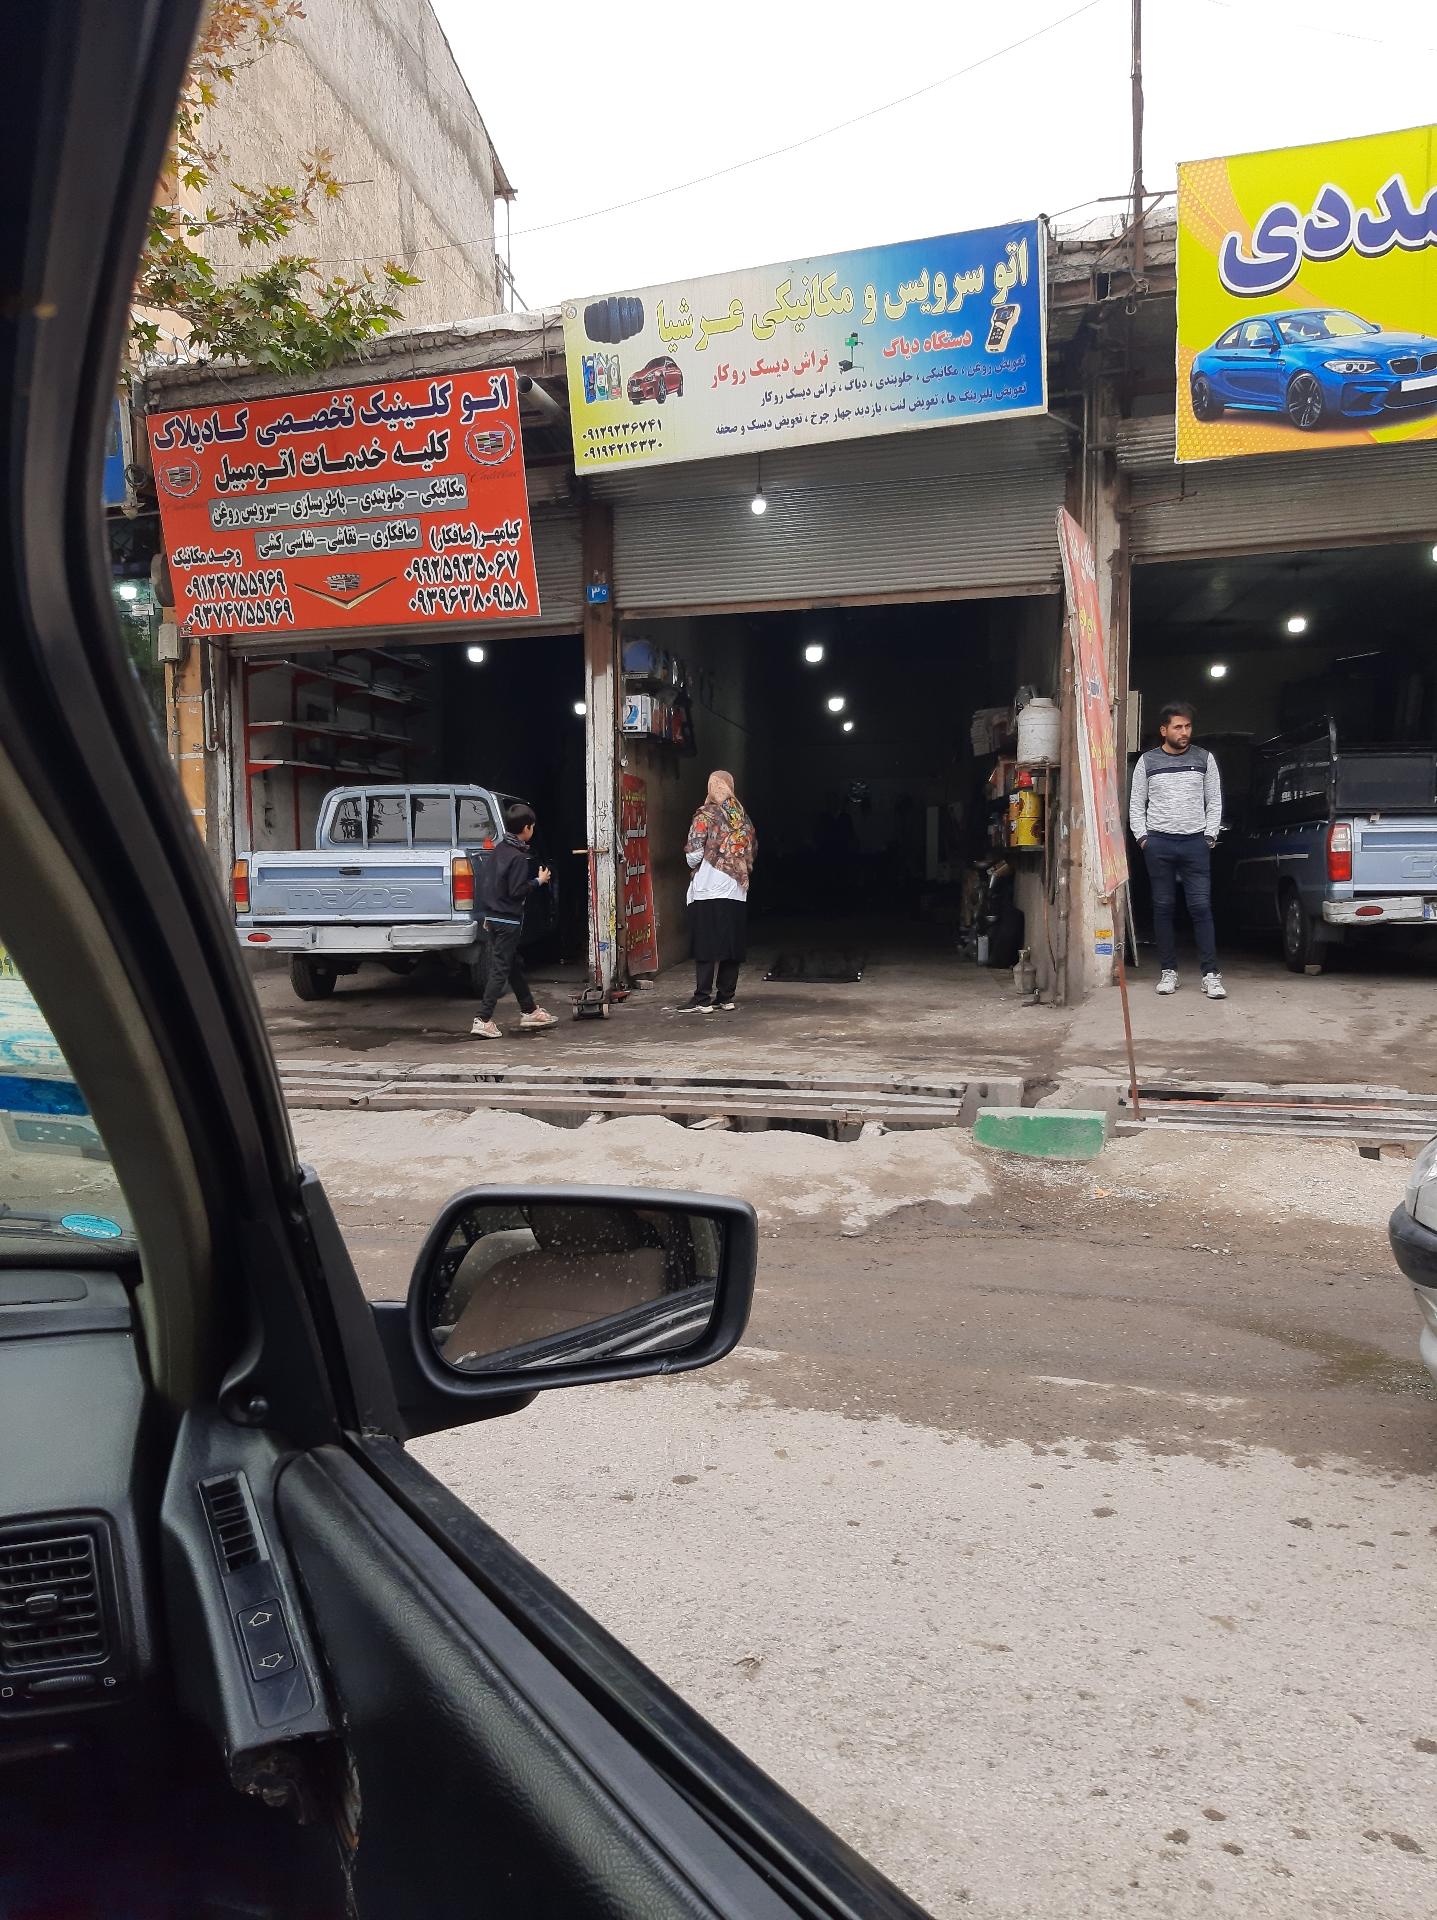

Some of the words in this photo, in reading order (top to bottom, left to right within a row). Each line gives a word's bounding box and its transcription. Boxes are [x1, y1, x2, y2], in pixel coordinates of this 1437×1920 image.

[991, 238, 1028, 306] اتو
[752, 271, 854, 341] مکانیکی
[862, 284, 877, 325] و
[885, 265, 985, 320] سرویس
[656, 297, 744, 353] عرشیا
[883, 336, 920, 359] دیاگ
[923, 330, 973, 352] دستگاه
[749, 358, 790, 378] دیسک
[793, 349, 829, 376] تراش
[921, 365, 959, 384] مکانیکی
[967, 362, 992, 377] روغن
[994, 354, 1026, 374] تعویض
[785, 388, 812, 400] دیسک
[813, 381, 837, 399] تراش
[844, 379, 868, 392] دیاگ
[875, 371, 913, 390] جلوبندی
[995, 382, 1027, 400] تعویض
[359, 381, 453, 431] کلینیک
[460, 373, 511, 425] اتو
[890, 398, 906, 411] لنت
[908, 393, 939, 412] تعویض
[153, 407, 250, 455] کادیلاک
[255, 394, 355, 447] تخصصی
[583, 419, 662, 441] ۰۹۱۲۹۲۳۶۷۴۱
[746, 418, 773, 432] دیسک
[774, 413, 803, 430] تعویض
[810, 411, 830, 425] چرخ
[300, 437, 388, 476] خدمات
[391, 429, 451, 472] کلیه
[584, 439, 663, 459] ۰۹۱۹۴۲۱۴۳۳۰
[214, 446, 297, 494] اتومبیل
[360, 483, 406, 513] جلوبندی
[420, 477, 466, 508] مکانیکی
[212, 500, 240, 527] روغن
[240, 502, 278, 524] سرویس
[259, 531, 283, 558] کشی
[285, 530, 315, 556] شاسی
[326, 526, 358, 553] نقاشی
[371, 519, 418, 549] صافکاری
[172, 546, 207, 571] مکانیک
[208, 548, 242, 567] وحید
[404, 550, 519, 585] ۰۹۹۲۵۹۳۵۰۶۷
[185, 569, 287, 601] ۰۹۱۲۴۷۵۵۹۶۹
[409, 581, 527, 615] ۰۹۳۹۶۳۸۰۹۵۸
[187, 598, 294, 629] ۰۹۳۷۴۷۵۵۹۶۹
